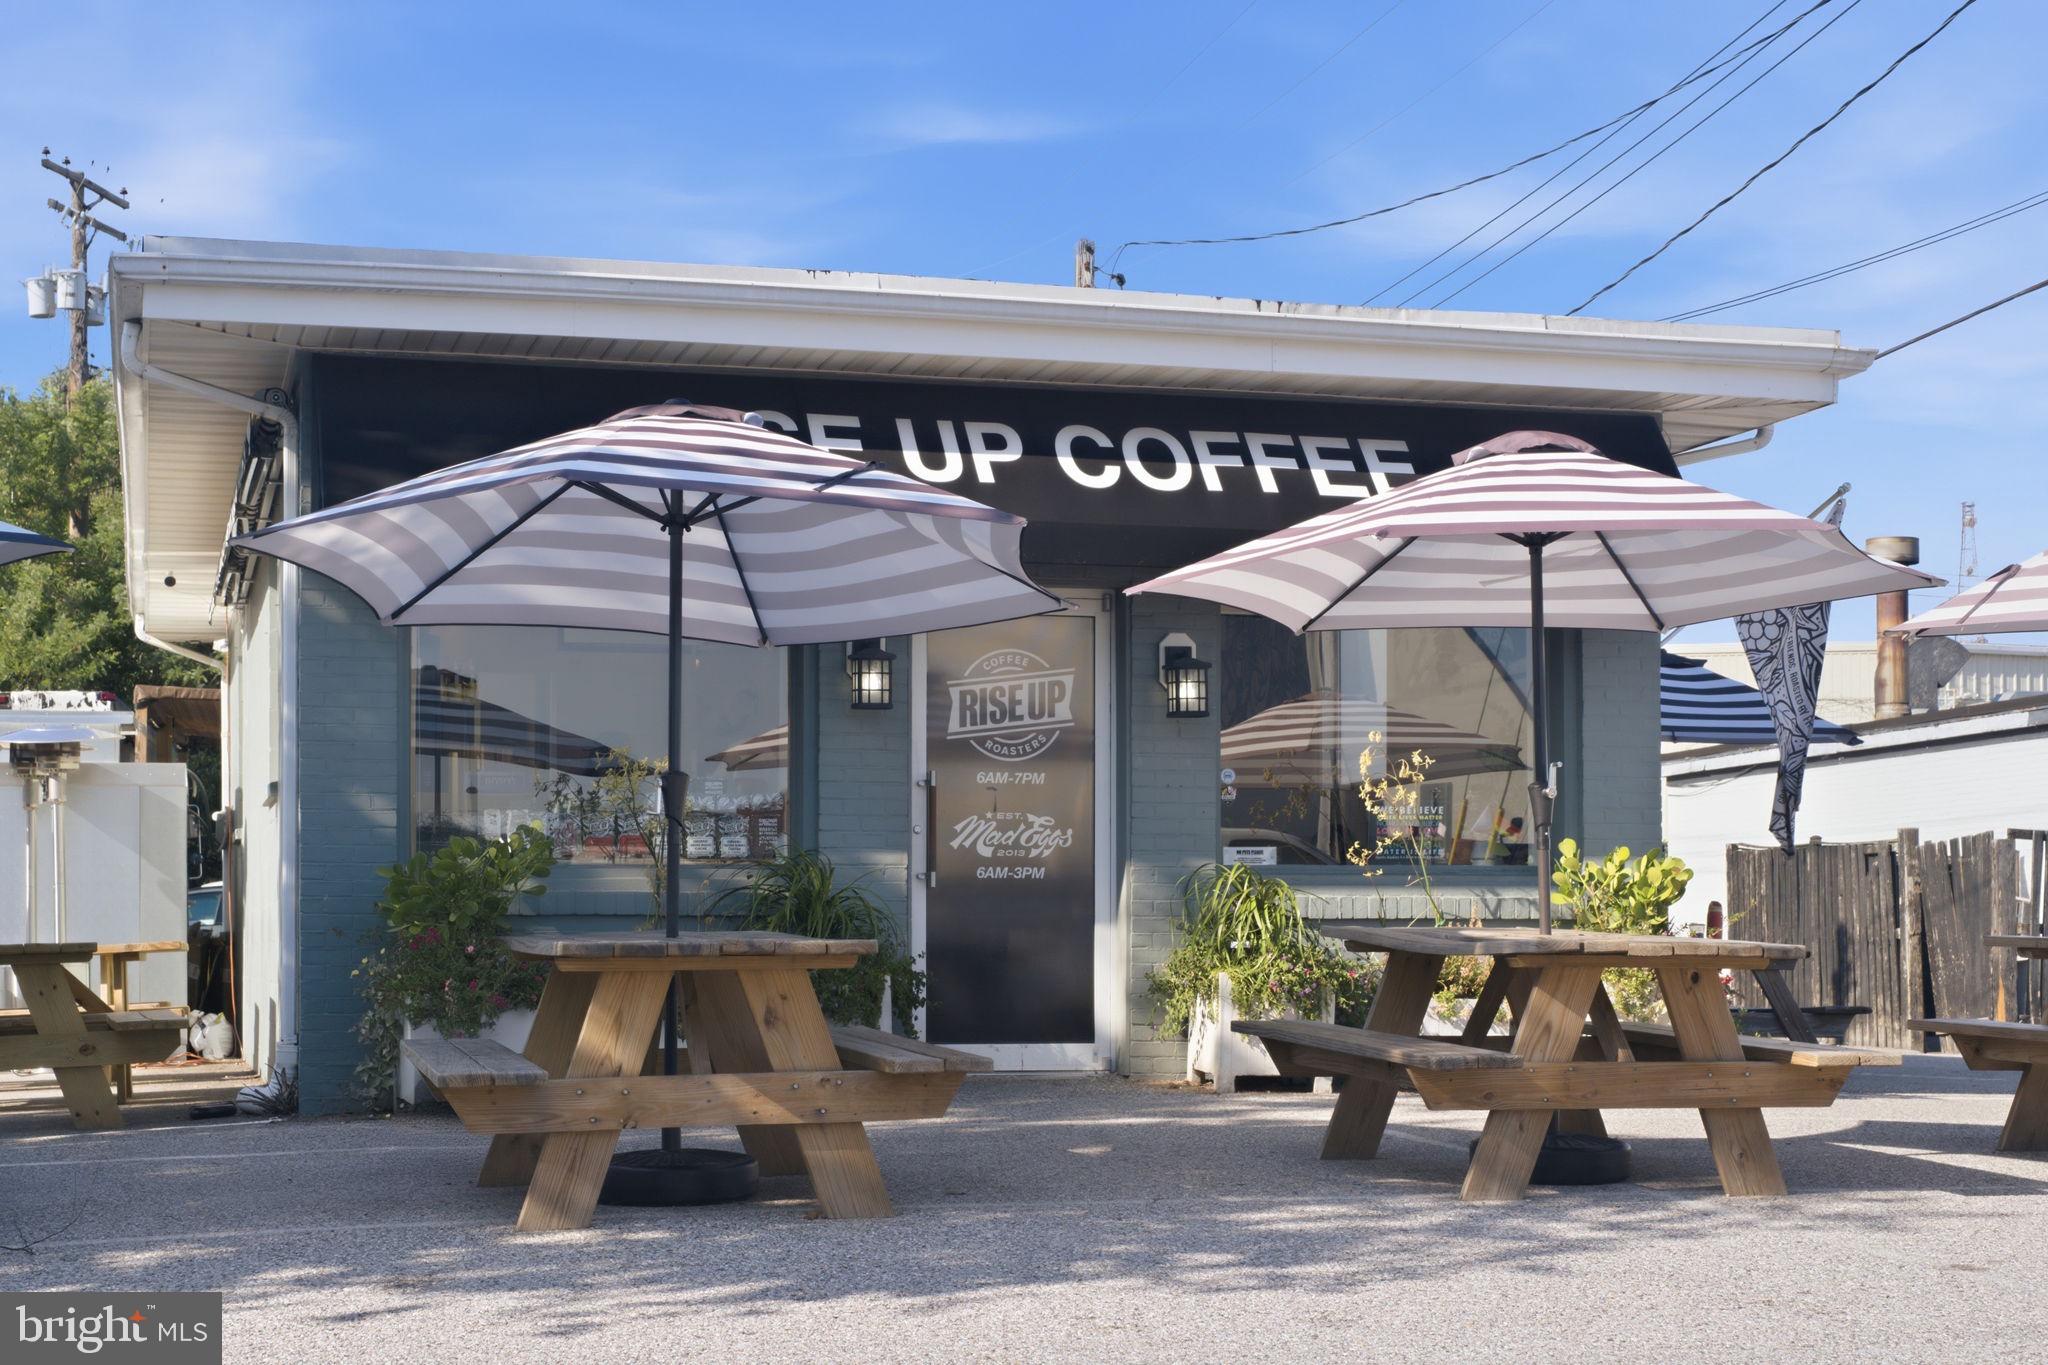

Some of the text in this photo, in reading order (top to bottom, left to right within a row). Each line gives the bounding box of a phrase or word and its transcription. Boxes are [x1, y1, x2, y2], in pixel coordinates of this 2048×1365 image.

[896, 419, 1023, 484] UP
[1054, 426, 1415, 498] COFFEE
[983, 655, 1029, 670] COFFEE
[959, 679, 1066, 729] RISE UP
[985, 734, 1047, 755] ROASTERS
[976, 771, 1046, 785] 6AM-7PM
[996, 812, 1024, 820] EST.
[949, 813, 1073, 858] Mad Eggs
[996, 849, 1026, 857] 2013
[976, 866, 1046, 879] 6AM-3PM
